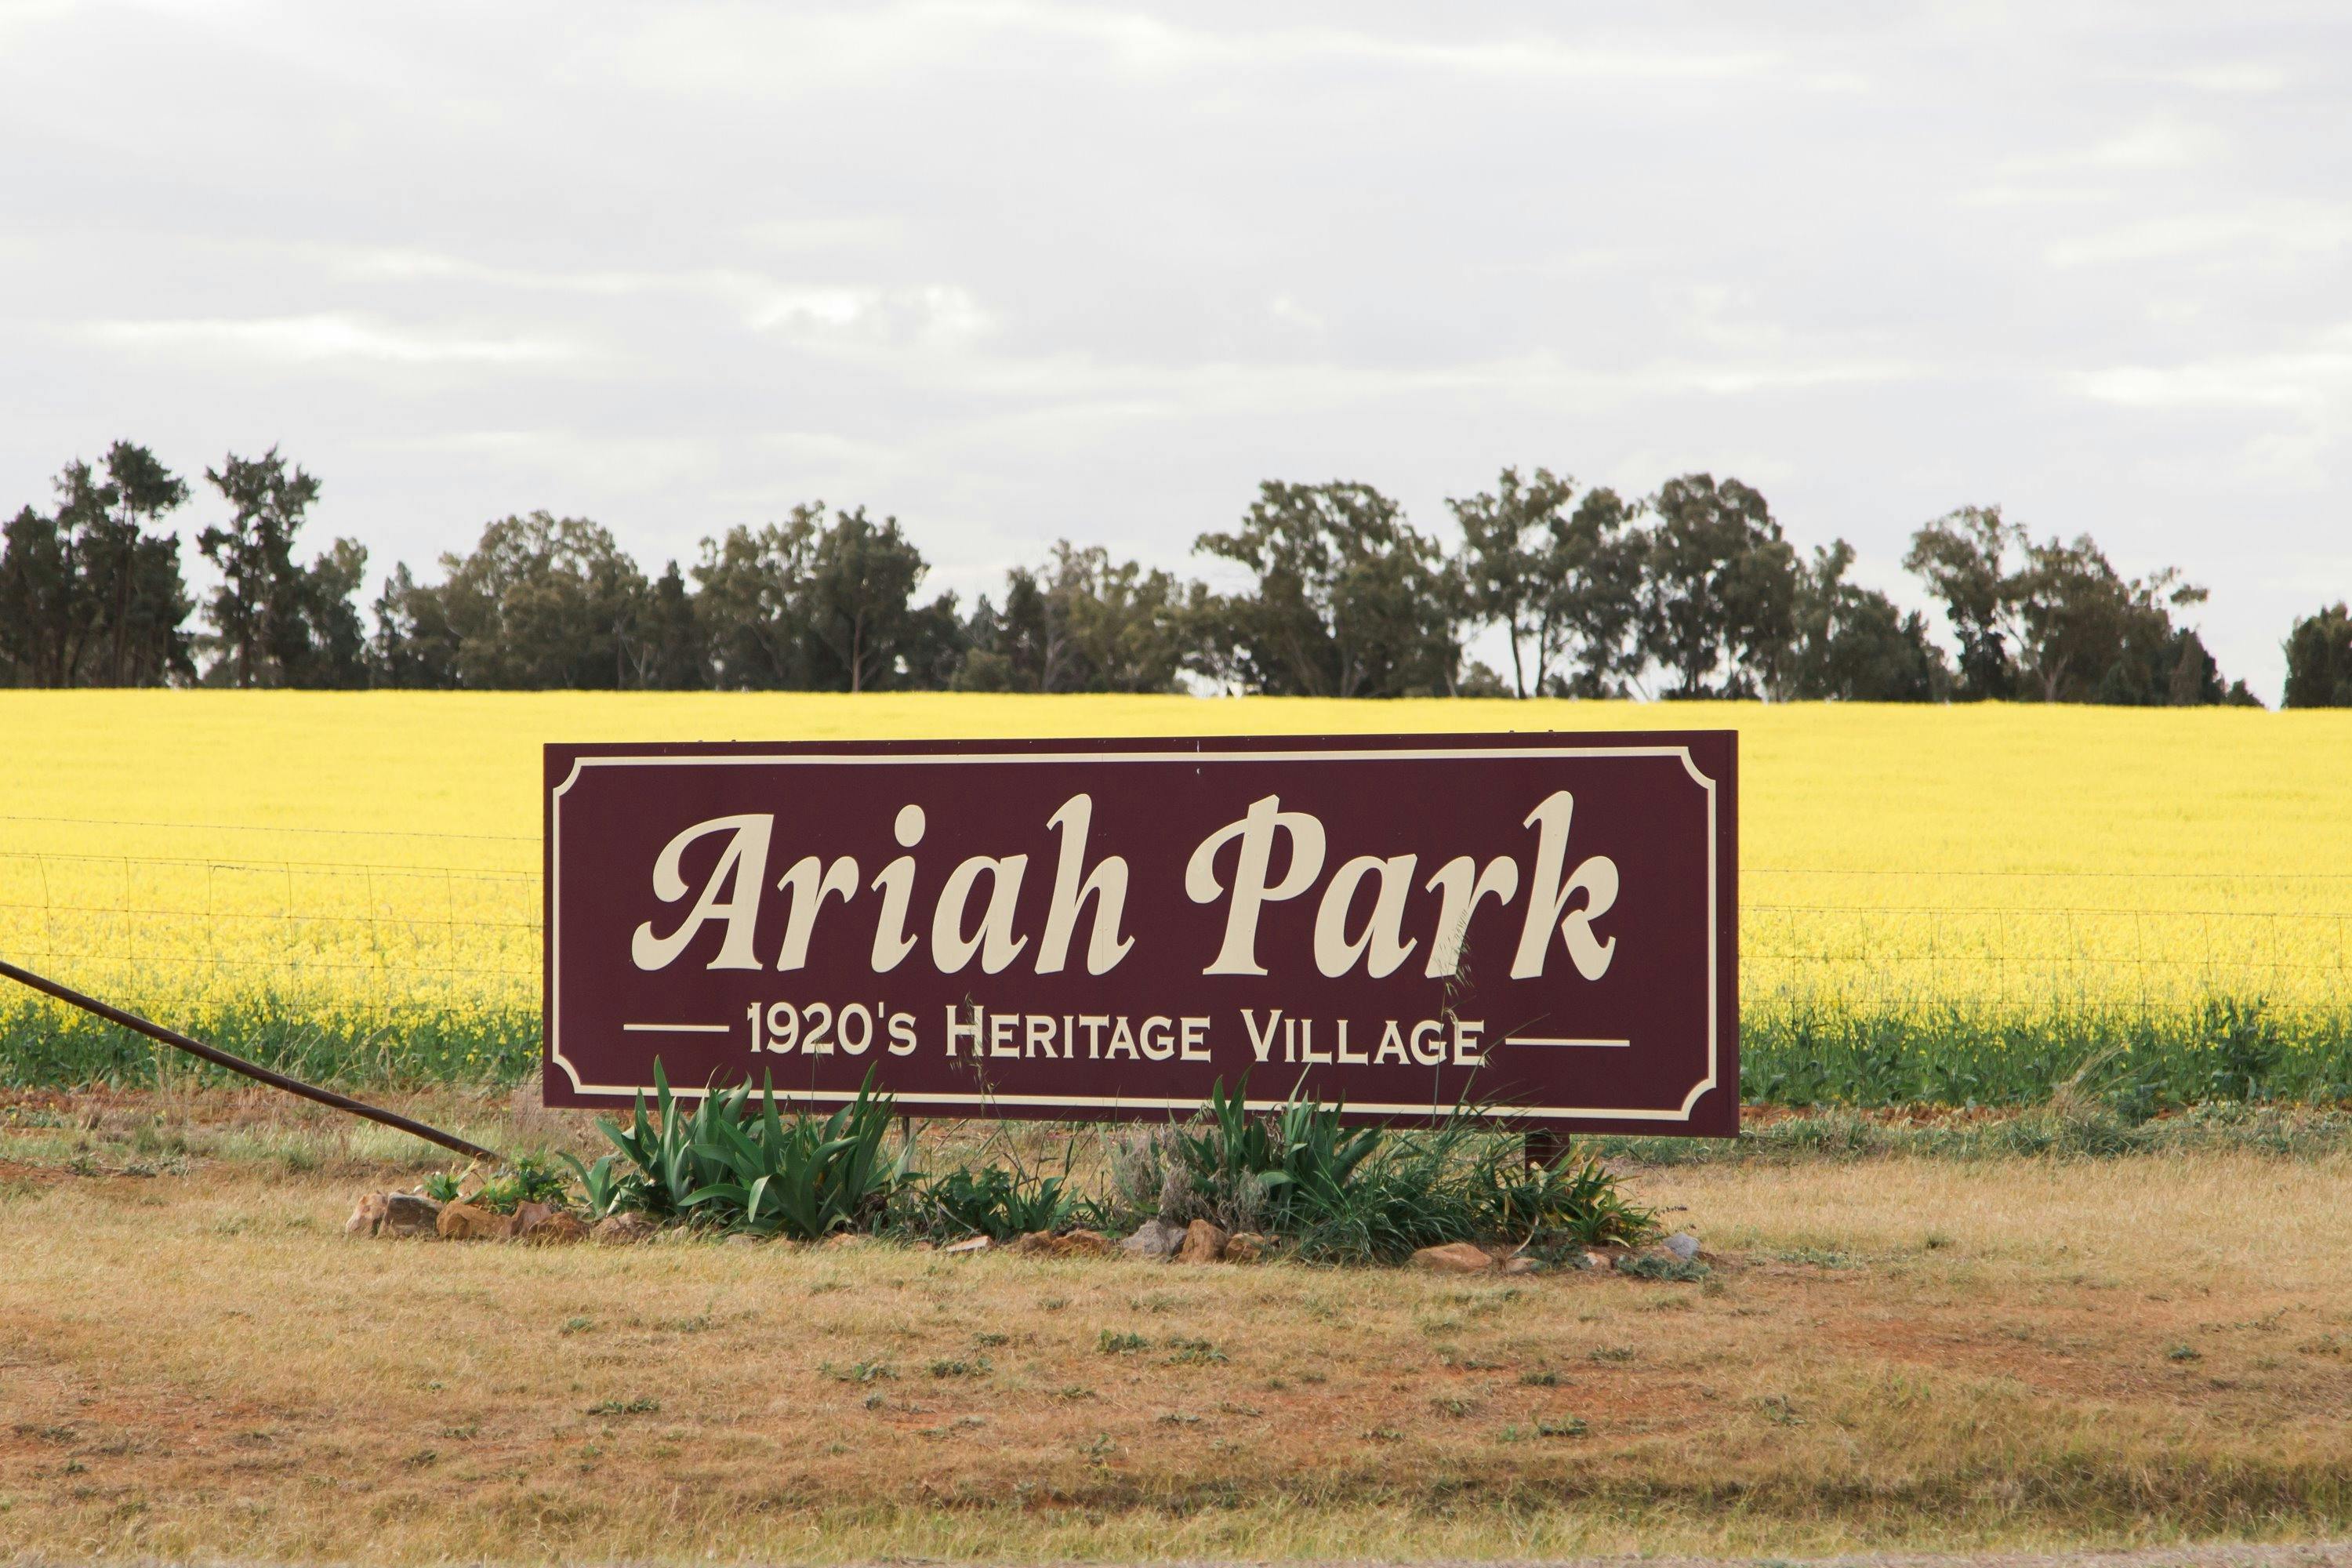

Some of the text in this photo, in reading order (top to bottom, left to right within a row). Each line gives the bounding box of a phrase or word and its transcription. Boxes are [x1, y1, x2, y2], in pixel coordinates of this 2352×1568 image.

[631, 790, 1620, 982] Ariah Park
[946, 1005, 1211, 1062] HERITAGE
[1240, 1009, 1485, 1069] VILLAGE
